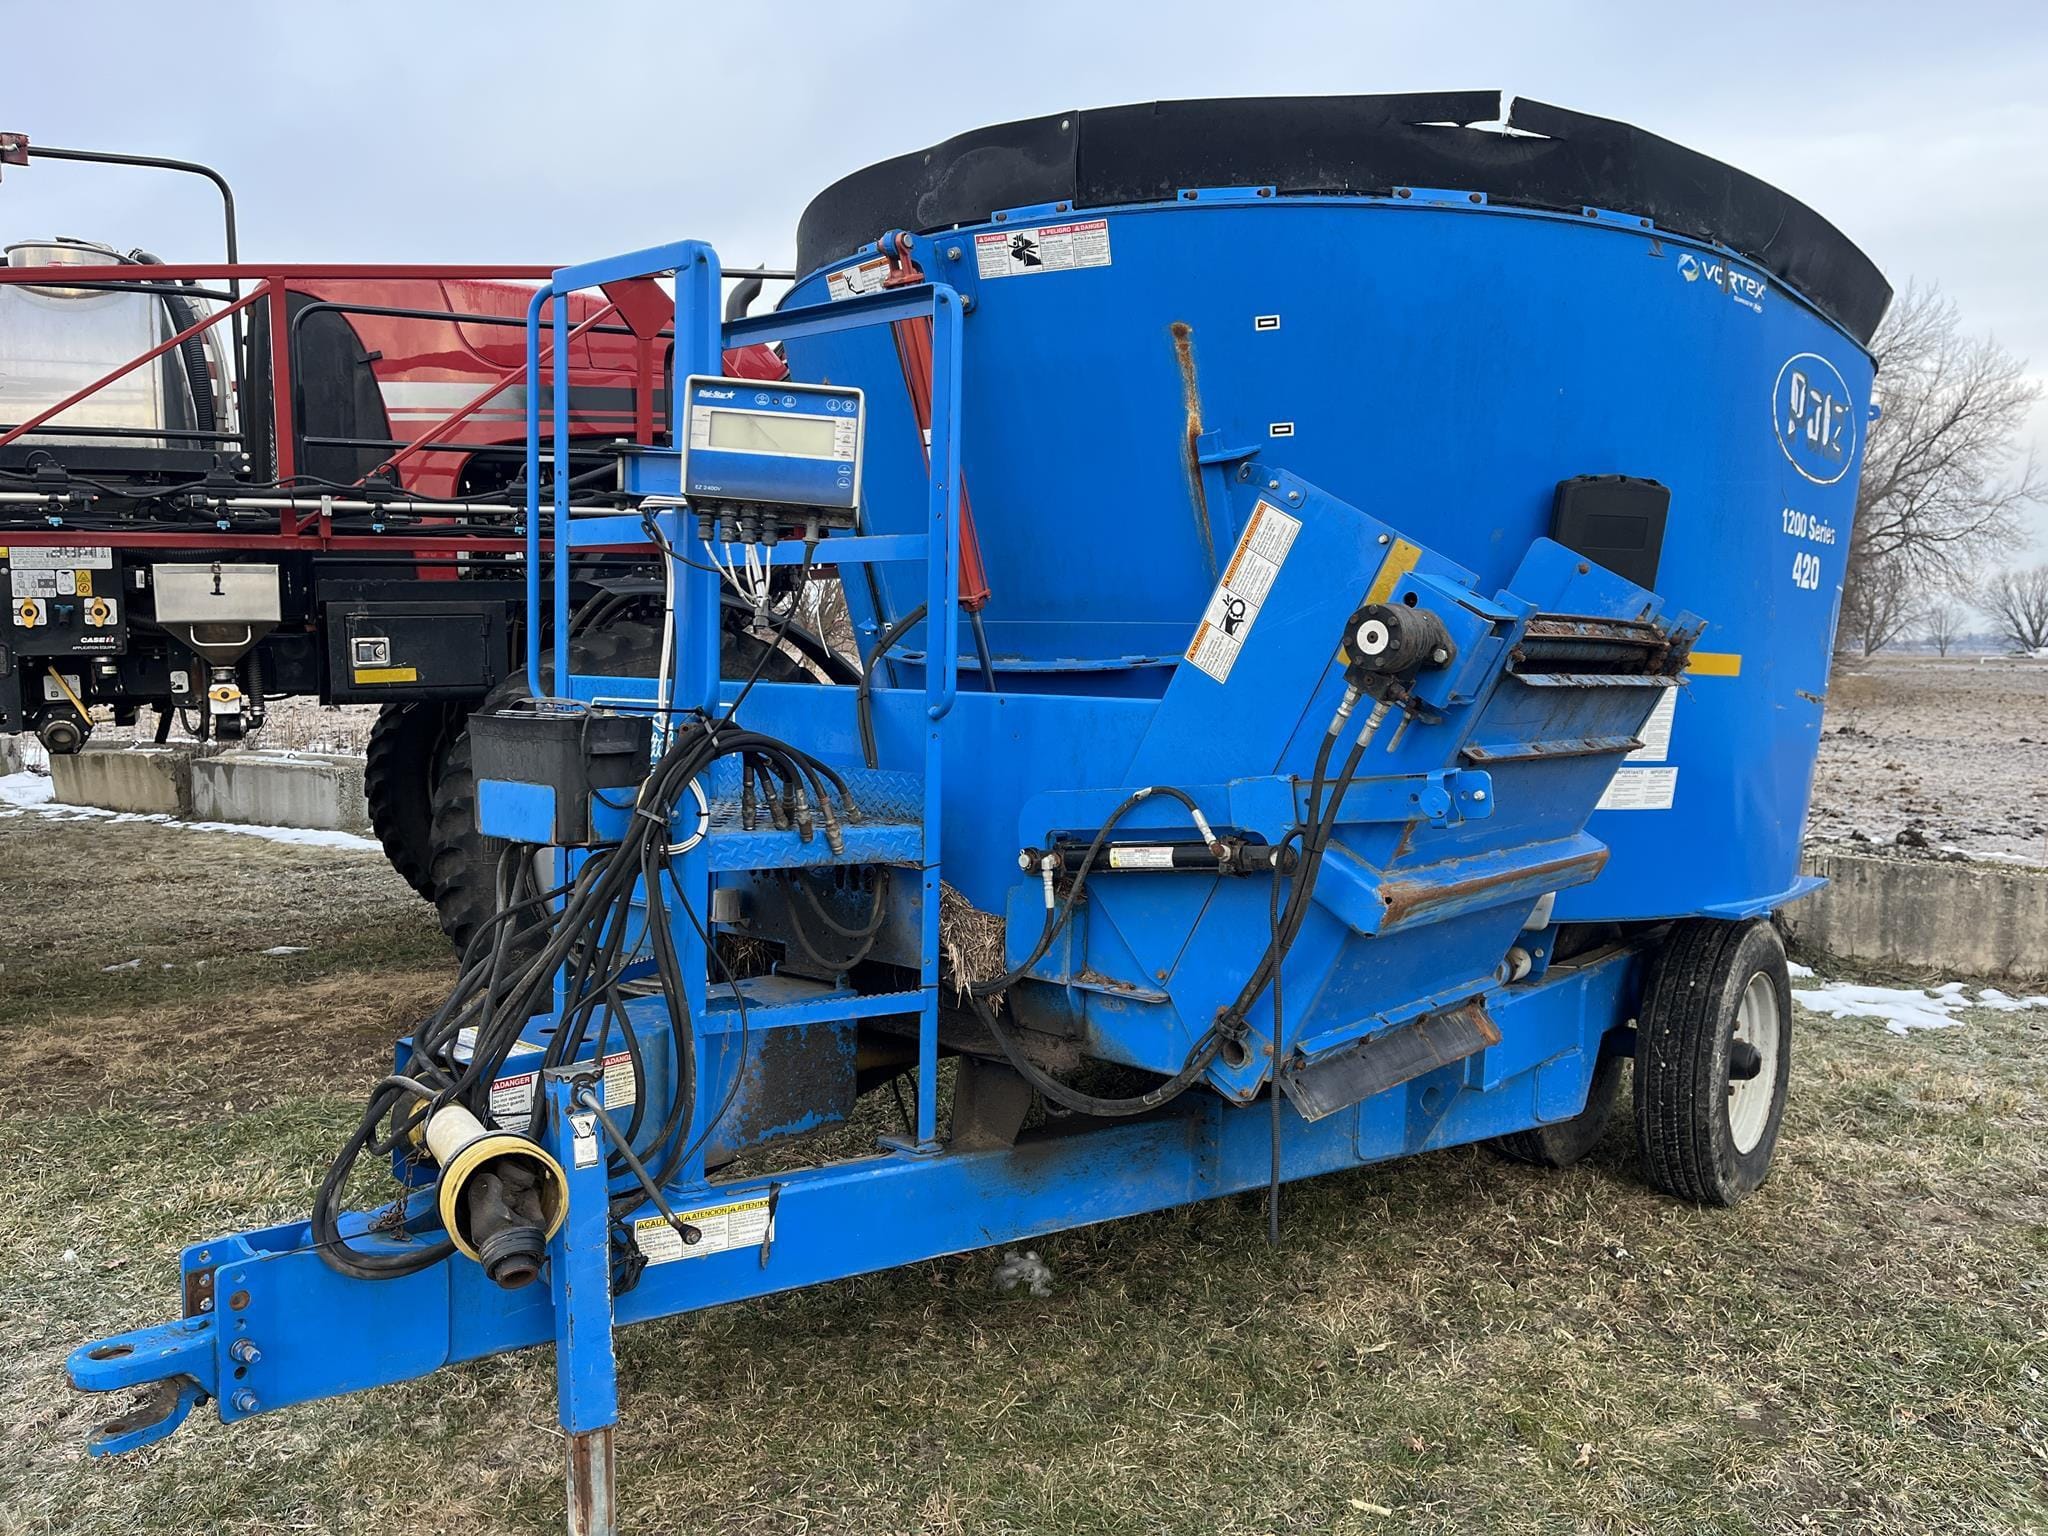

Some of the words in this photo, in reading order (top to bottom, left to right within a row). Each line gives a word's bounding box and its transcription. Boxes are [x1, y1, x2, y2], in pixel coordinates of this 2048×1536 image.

[1046, 226, 1070, 234] PELIGRO
[1080, 222, 1104, 230] DANGER
[1782, 507, 1807, 538] 1200
[1808, 515, 1836, 545] Series
[1792, 551, 1820, 591] 420
[1192, 623, 1209, 651] WARNING
[500, 1077, 530, 1088] DANGER
[692, 1208, 727, 1219] ATENCION
